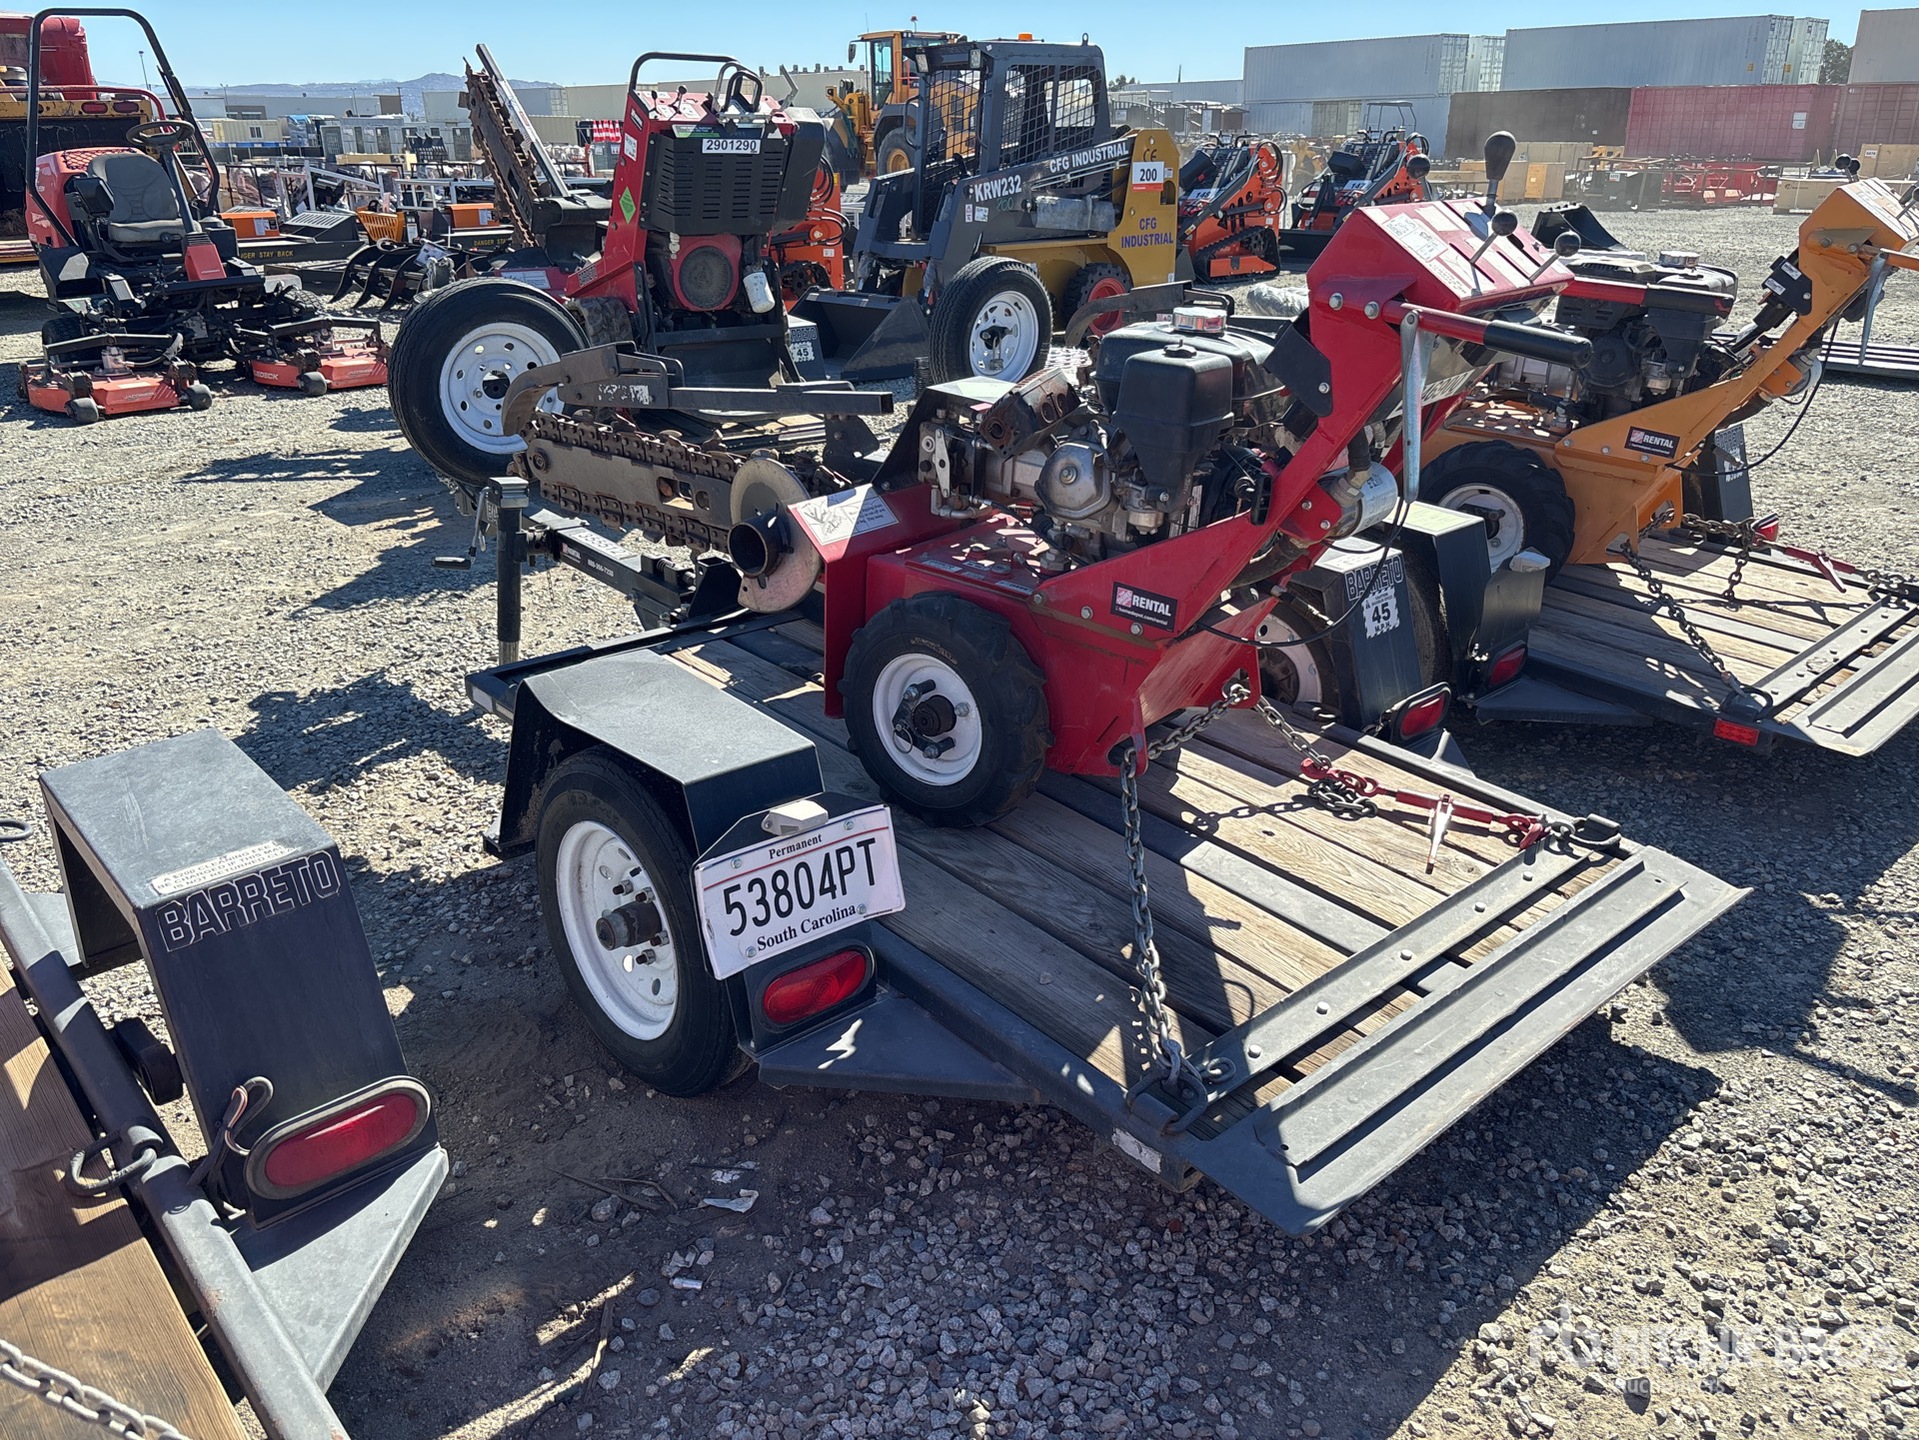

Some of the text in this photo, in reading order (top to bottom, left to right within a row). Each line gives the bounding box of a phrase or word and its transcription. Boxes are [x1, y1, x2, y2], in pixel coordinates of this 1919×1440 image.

[706, 140, 757, 151] 2901290
[1049, 142, 1129, 174] CFG INDUSTRIAL
[1139, 168, 1158, 182] 200
[974, 174, 1022, 202] KRW232
[1139, 217, 1157, 230] CFG
[1121, 232, 1174, 249] INDUSTRIAL
[259, 251, 274, 259] STAY
[277, 250, 294, 258] BACK
[796, 348, 809, 357] 45
[1643, 434, 1674, 449] RENTAL
[1132, 594, 1172, 618] RENTAL
[1372, 602, 1391, 624] 45
[768, 833, 822, 860] Permanent
[198, 852, 250, 871] CLEANING
[210, 857, 266, 878] RETURNED
[175, 865, 226, 884] CHARGED
[723, 837, 877, 937] 53804PT
[156, 851, 341, 952] BARRETO
[757, 905, 856, 951] South Carolina
